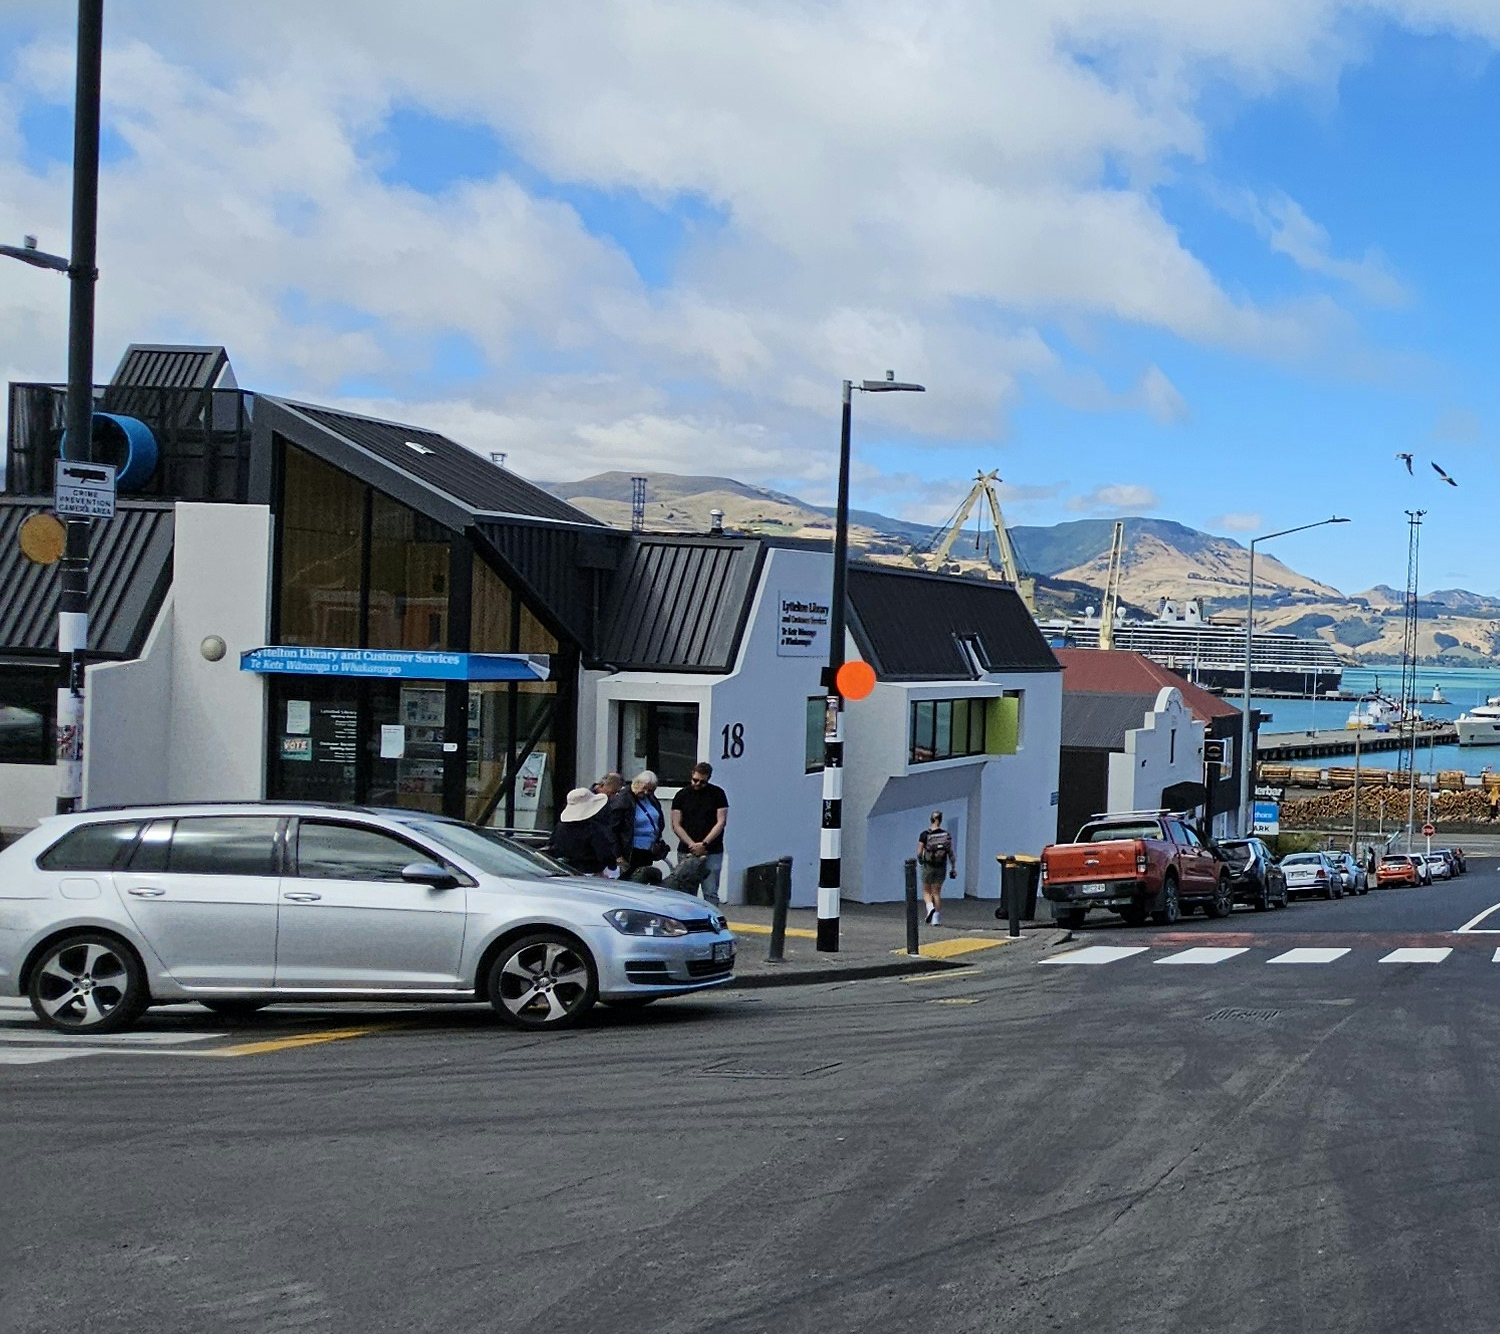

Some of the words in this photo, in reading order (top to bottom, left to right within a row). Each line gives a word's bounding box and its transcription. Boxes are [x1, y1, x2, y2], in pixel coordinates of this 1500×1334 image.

[73, 490, 98, 498] CRIME
[59, 496, 111, 507] PREVENTION
[59, 504, 90, 513] CAMERA
[93, 507, 111, 515] AREA
[809, 602, 829, 617] Library
[300, 649, 338, 661] Library
[341, 651, 361, 660] and
[364, 652, 413, 663] Customer
[415, 653, 460, 665] Services
[251, 659, 261, 668] Te
[263, 660, 284, 669] Kete
[283, 739, 308, 751] VOTE
[721, 723, 744, 759] 18
